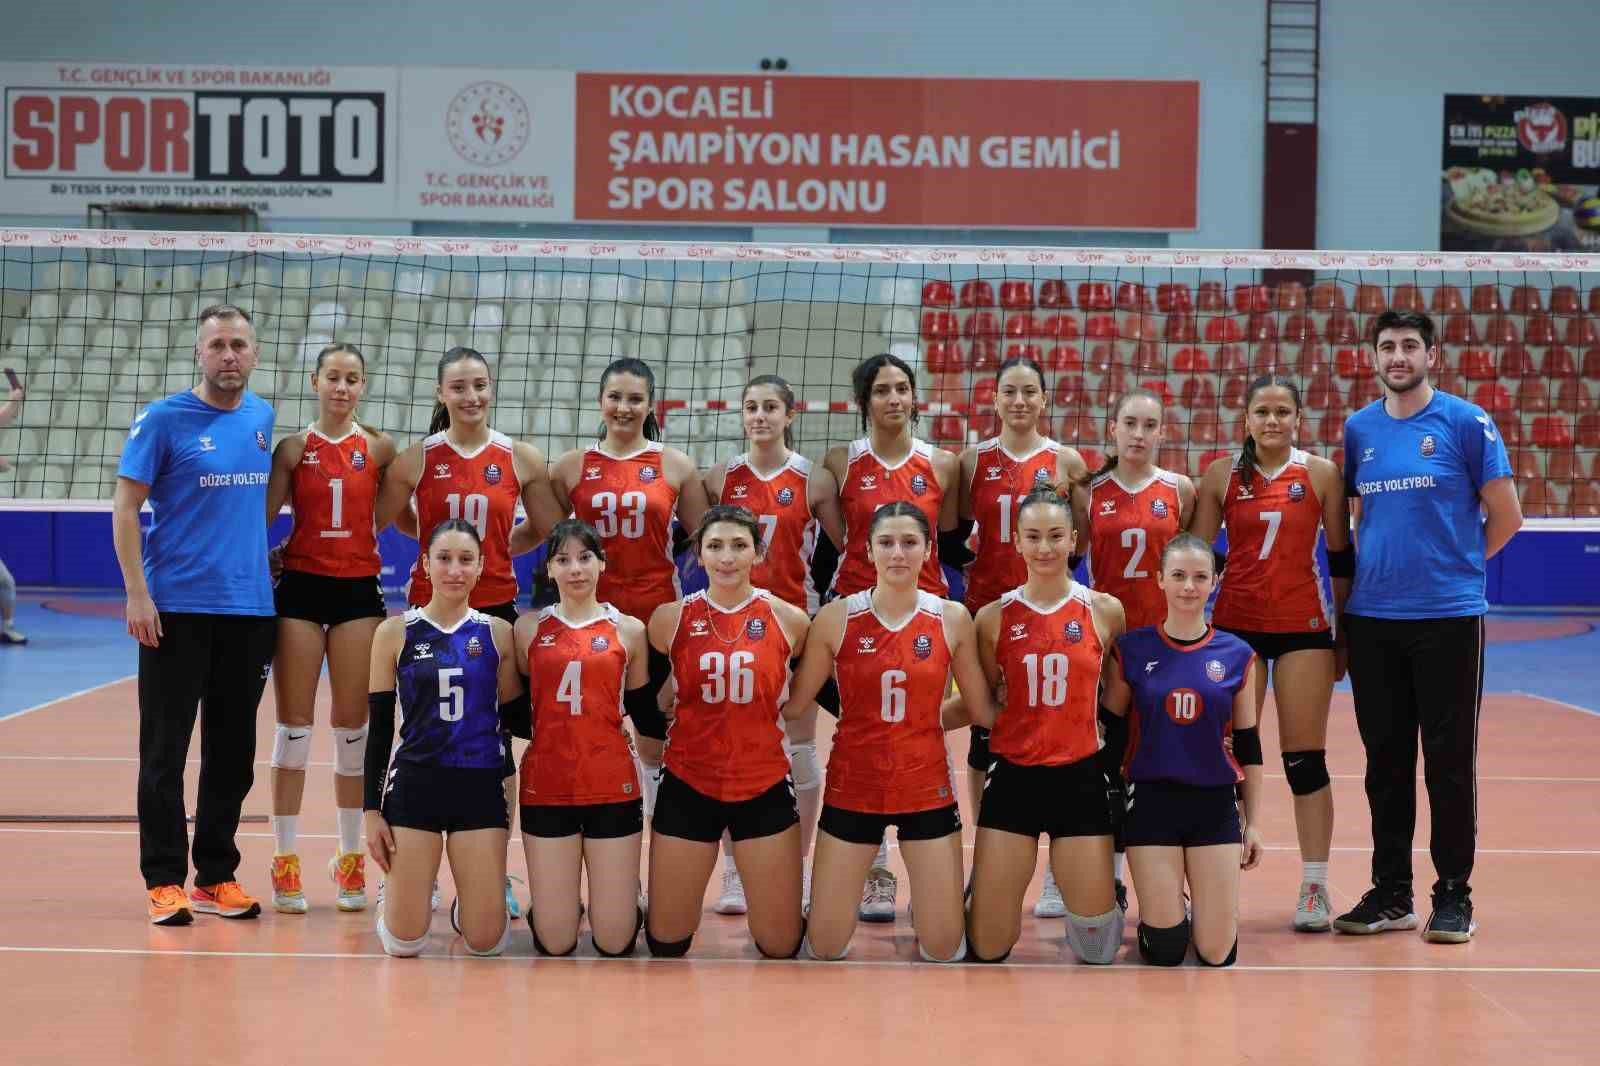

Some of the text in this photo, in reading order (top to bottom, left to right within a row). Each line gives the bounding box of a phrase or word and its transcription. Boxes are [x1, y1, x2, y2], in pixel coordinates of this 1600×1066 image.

[58, 67, 331, 87] T.C. GENÇLİK VE SPOR BAKANLIĞI
[608, 80, 773, 119] KOCAELİ
[12, 95, 379, 176] SPOR TOTO
[608, 126, 1121, 171] ŞAMPİYON HASAN GEMİCİ
[106, 185, 137, 196] SPOR
[140, 185, 171, 196] TOTO
[420, 191, 555, 208] SPOR BAKANLIĞI
[425, 170, 549, 190] T.C. GENÇLİK VE
[608, 178, 887, 212] SPOR SALONU
[200, 473, 231, 488] DÜZCE
[327, 478, 343, 529] 1
[1358, 474, 1437, 496] ÜZCE VOLEYBOL
[445, 493, 489, 542] 19
[591, 491, 648, 539] 33
[1259, 511, 1282, 561] 7
[1120, 527, 1149, 579] 2
[438, 667, 465, 722] 5
[556, 660, 584, 716] 4
[699, 650, 756, 704] 36
[880, 669, 907, 724] 6
[1021, 653, 1070, 708] 18
[1171, 691, 1197, 721] 10
